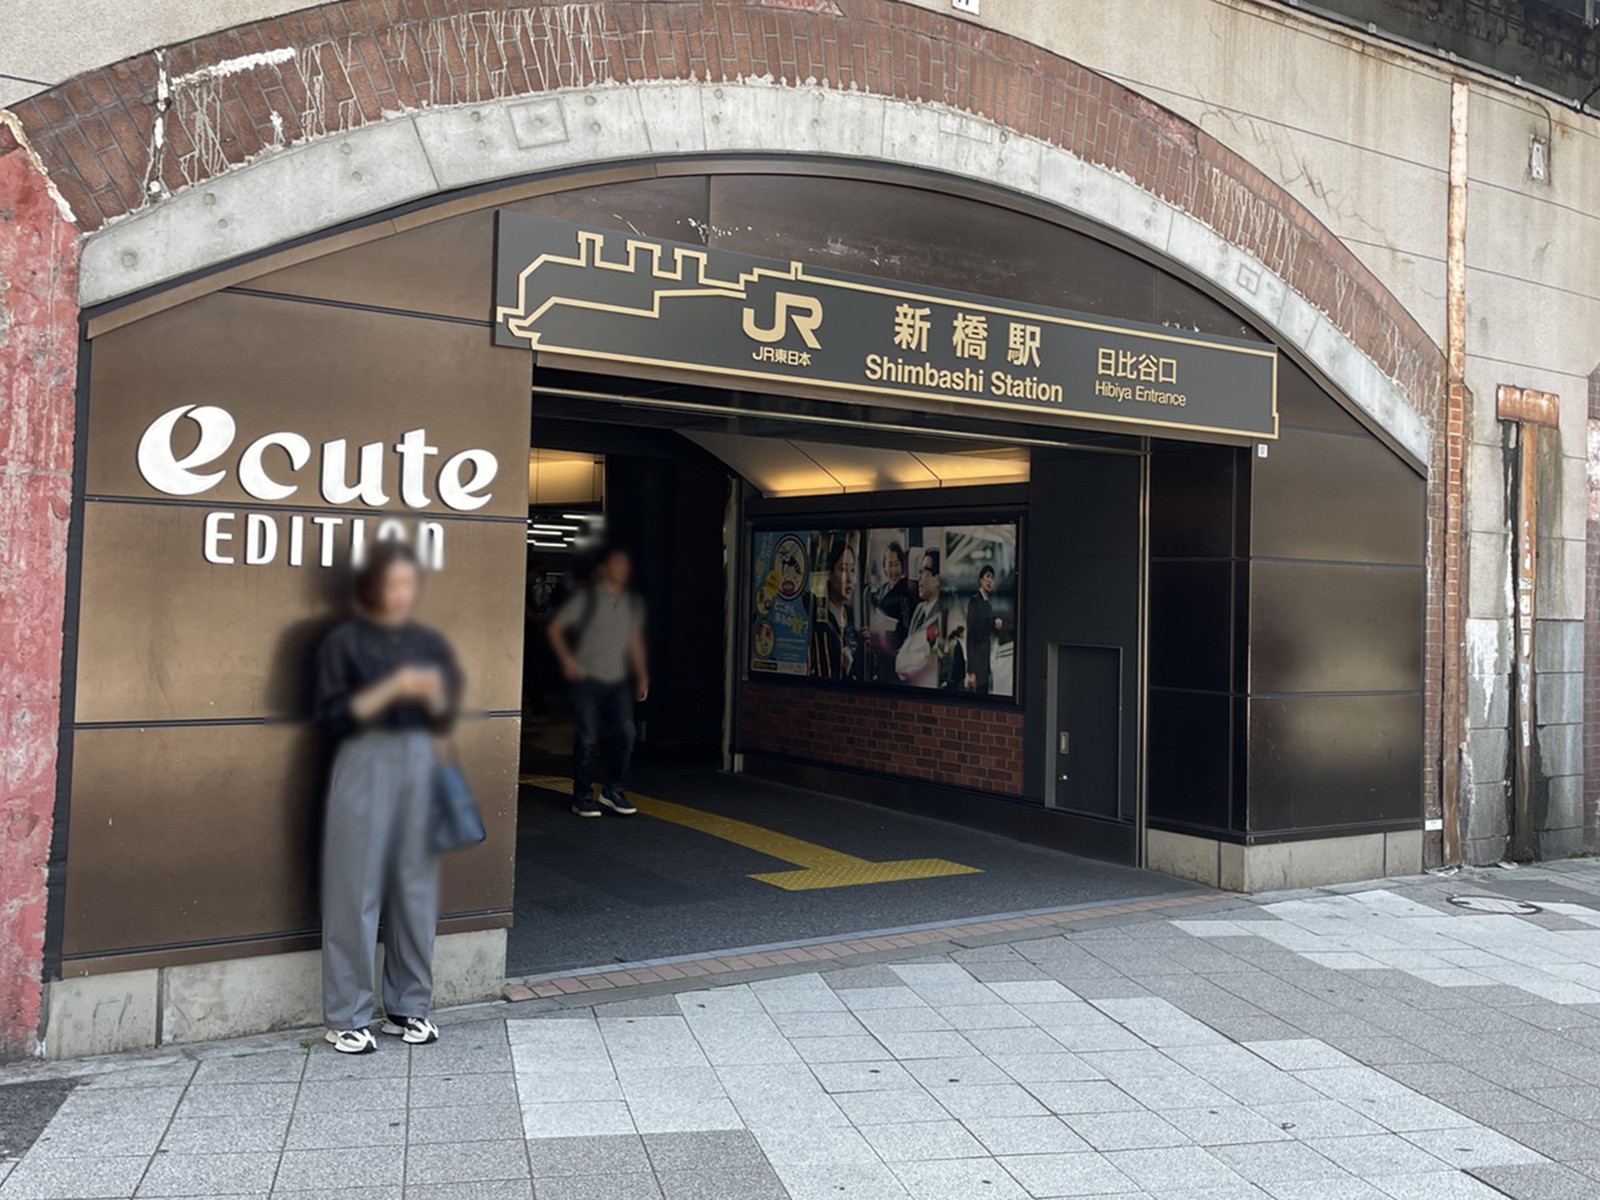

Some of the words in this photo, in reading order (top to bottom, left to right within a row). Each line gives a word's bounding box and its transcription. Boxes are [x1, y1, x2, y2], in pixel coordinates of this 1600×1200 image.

[742, 291, 823, 349] JR
[893, 303, 1041, 368] 新橋駅
[752, 346, 812, 367] JR東日本
[865, 354, 984, 393] Shimbashi
[990, 371, 1063, 402] Station
[1097, 348, 1177, 384] 日比谷口
[1095, 380, 1132, 402] Hibiya
[1135, 386, 1187, 407] Entrance
[137, 404, 498, 511] ecute
